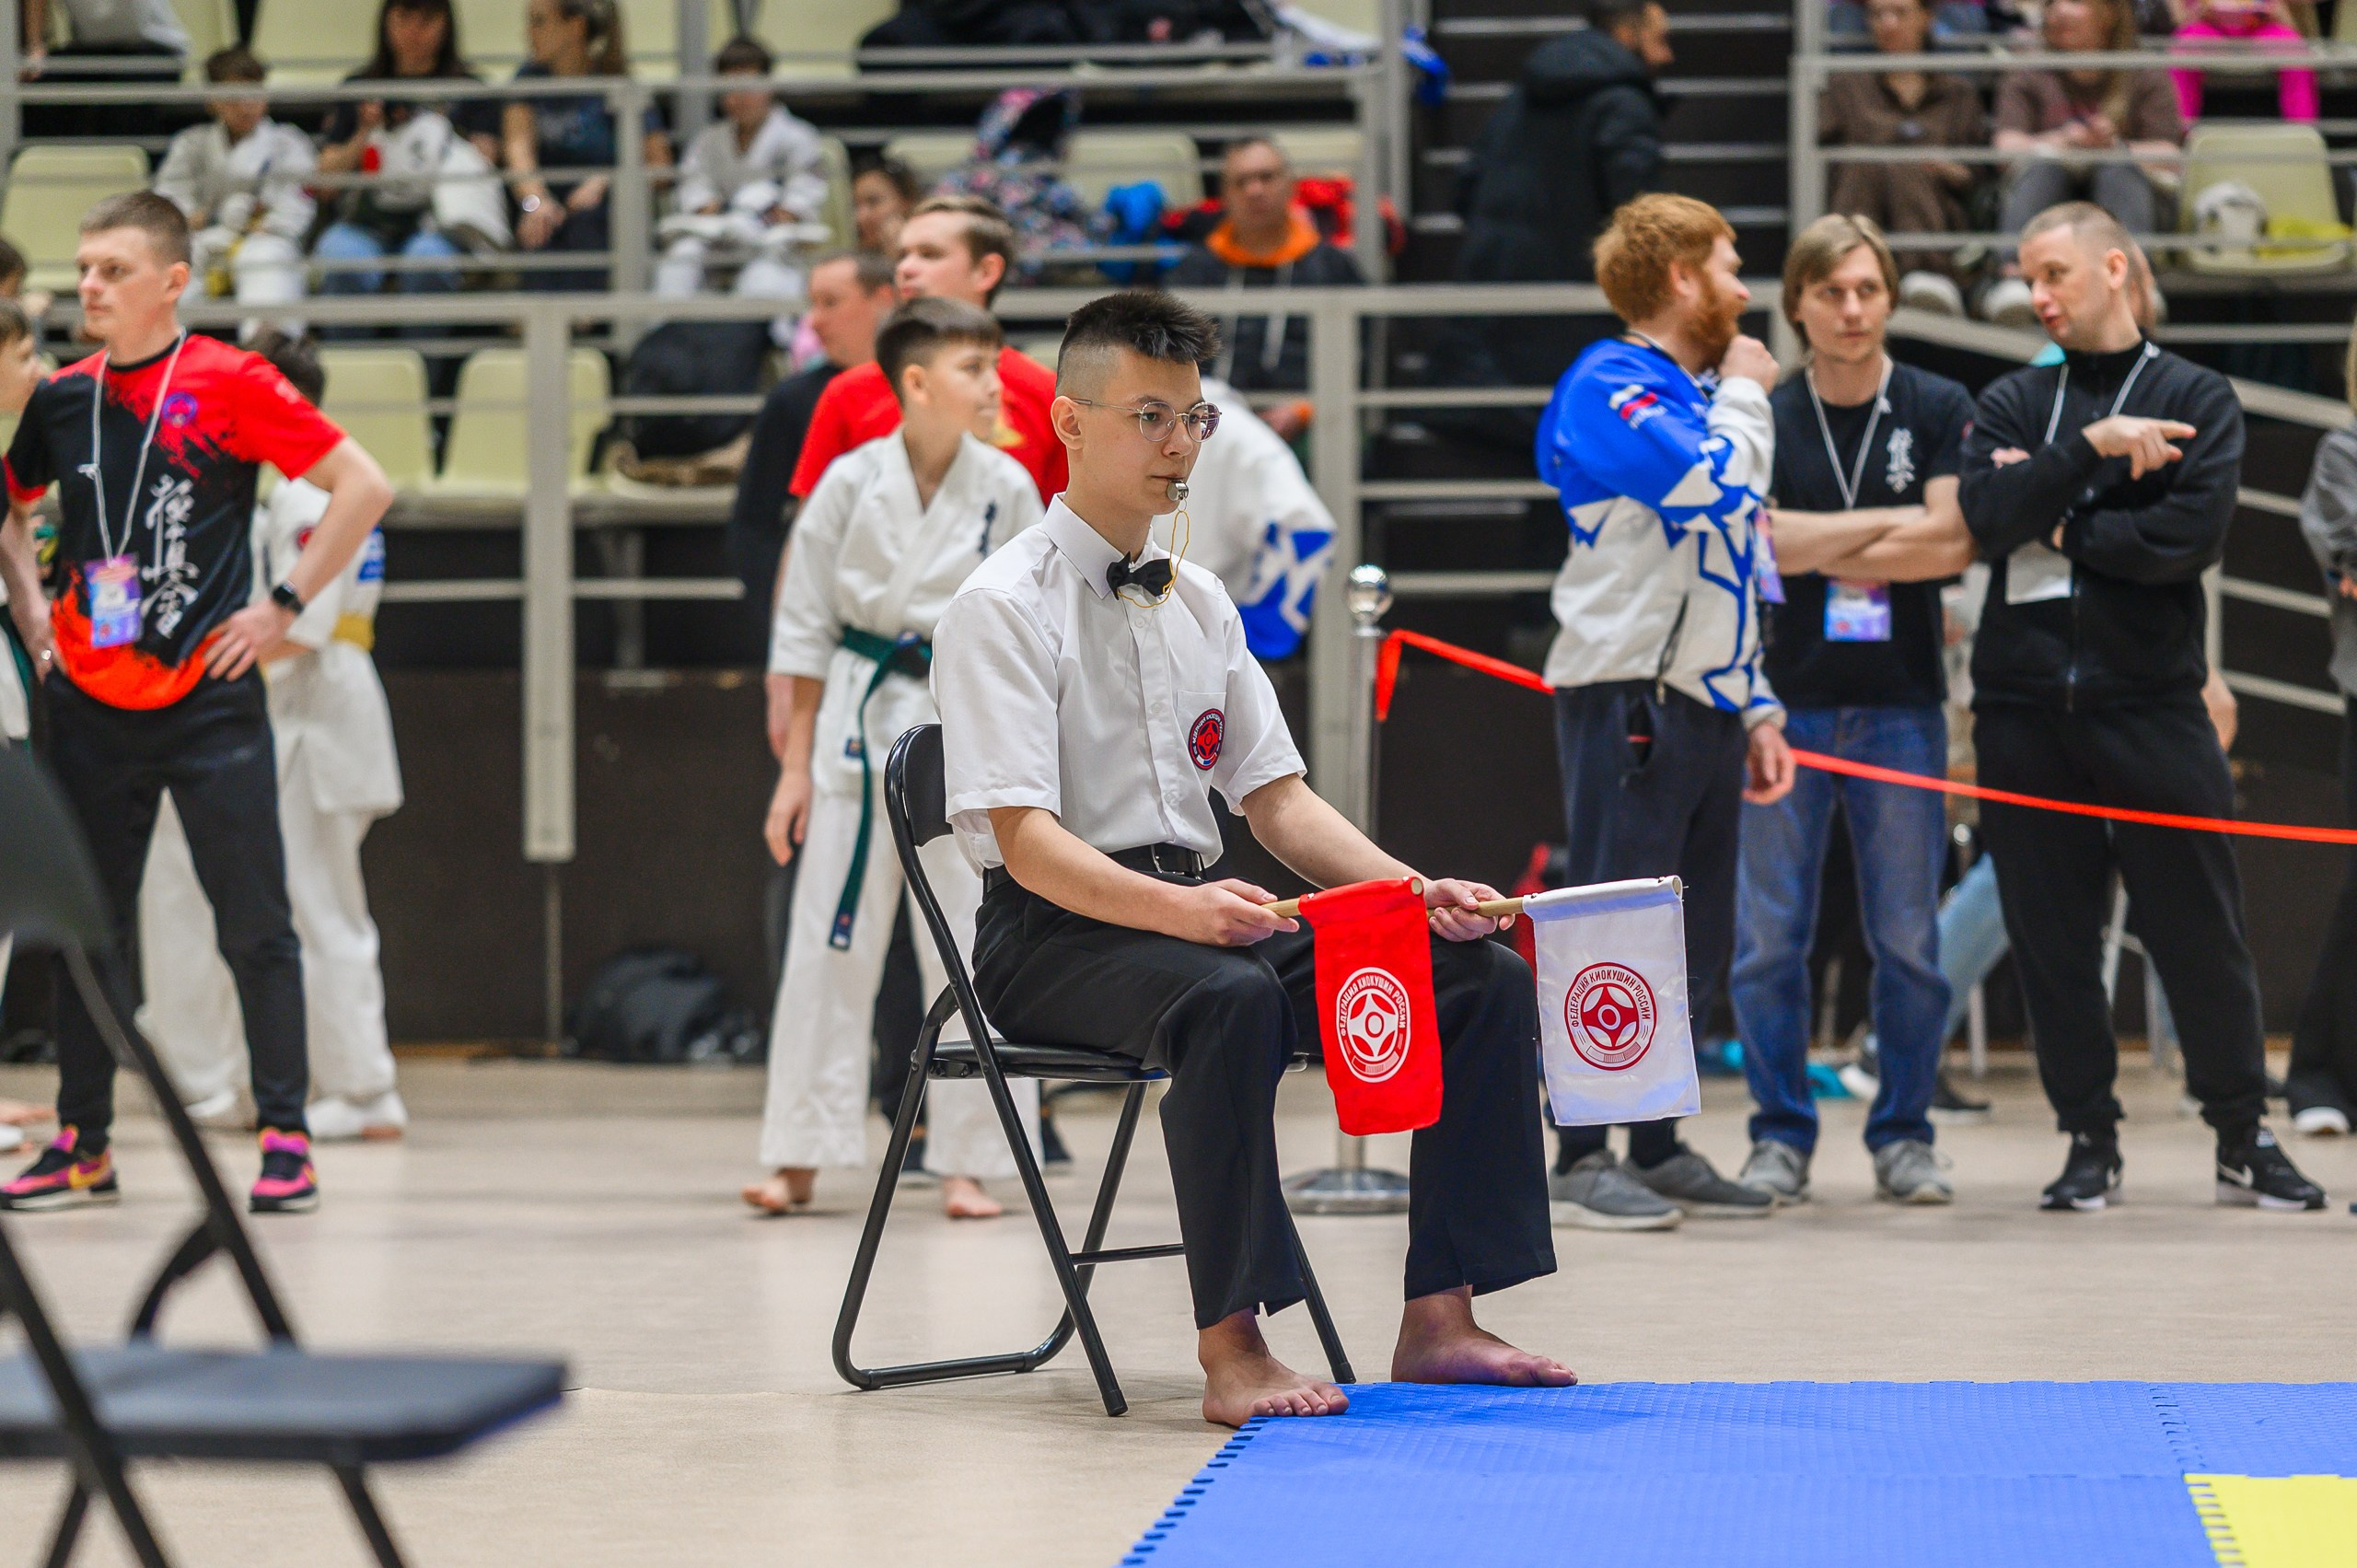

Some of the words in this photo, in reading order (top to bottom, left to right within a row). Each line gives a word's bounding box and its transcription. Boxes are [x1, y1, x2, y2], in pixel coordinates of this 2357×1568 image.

[1340, 982, 1359, 1037] ФЕДЕРАЦИЯ
[1391, 990, 1406, 1028] РОССИИ
[1570, 977, 1590, 1028] ФЕДЕРАЦИЯ
[1588, 969, 1636, 988] КИОКУШИН
[1633, 984, 1651, 1019] РОССИИ
